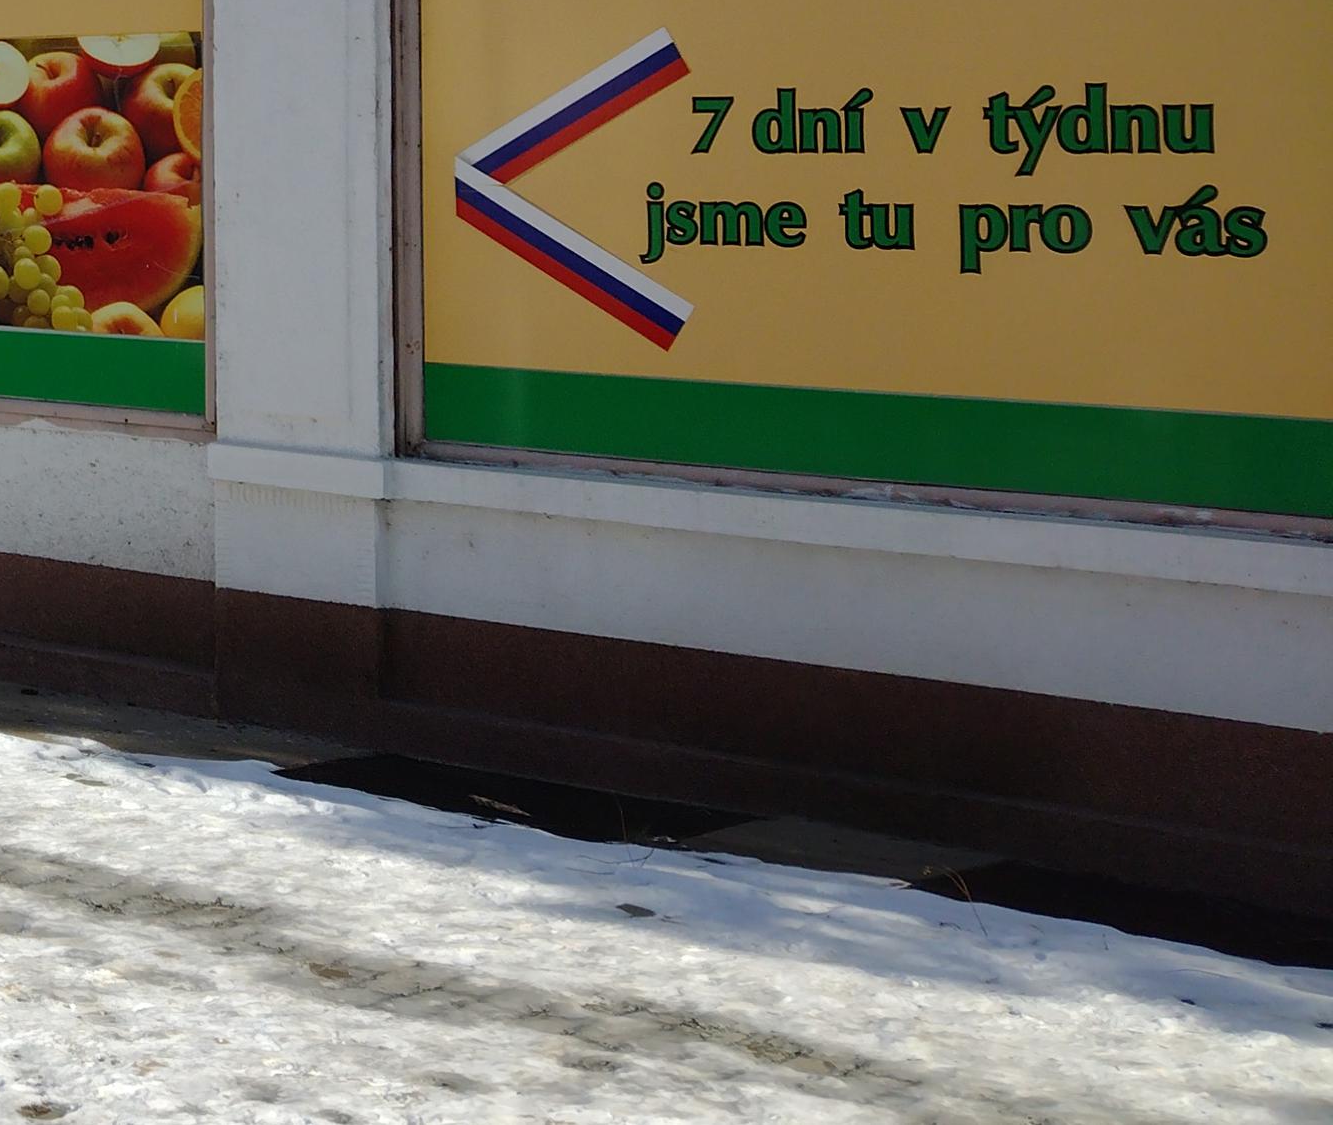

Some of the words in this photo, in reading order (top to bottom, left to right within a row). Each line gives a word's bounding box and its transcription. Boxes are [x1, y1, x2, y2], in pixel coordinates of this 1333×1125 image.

[691, 96, 734, 154] 7
[751, 87, 875, 154] dní
[899, 105, 952, 155] v
[982, 82, 1216, 177] týdnu
[639, 182, 808, 264] jsme
[838, 188, 916, 251] tu
[959, 197, 1094, 274] pro
[1123, 185, 1271, 258] vás
